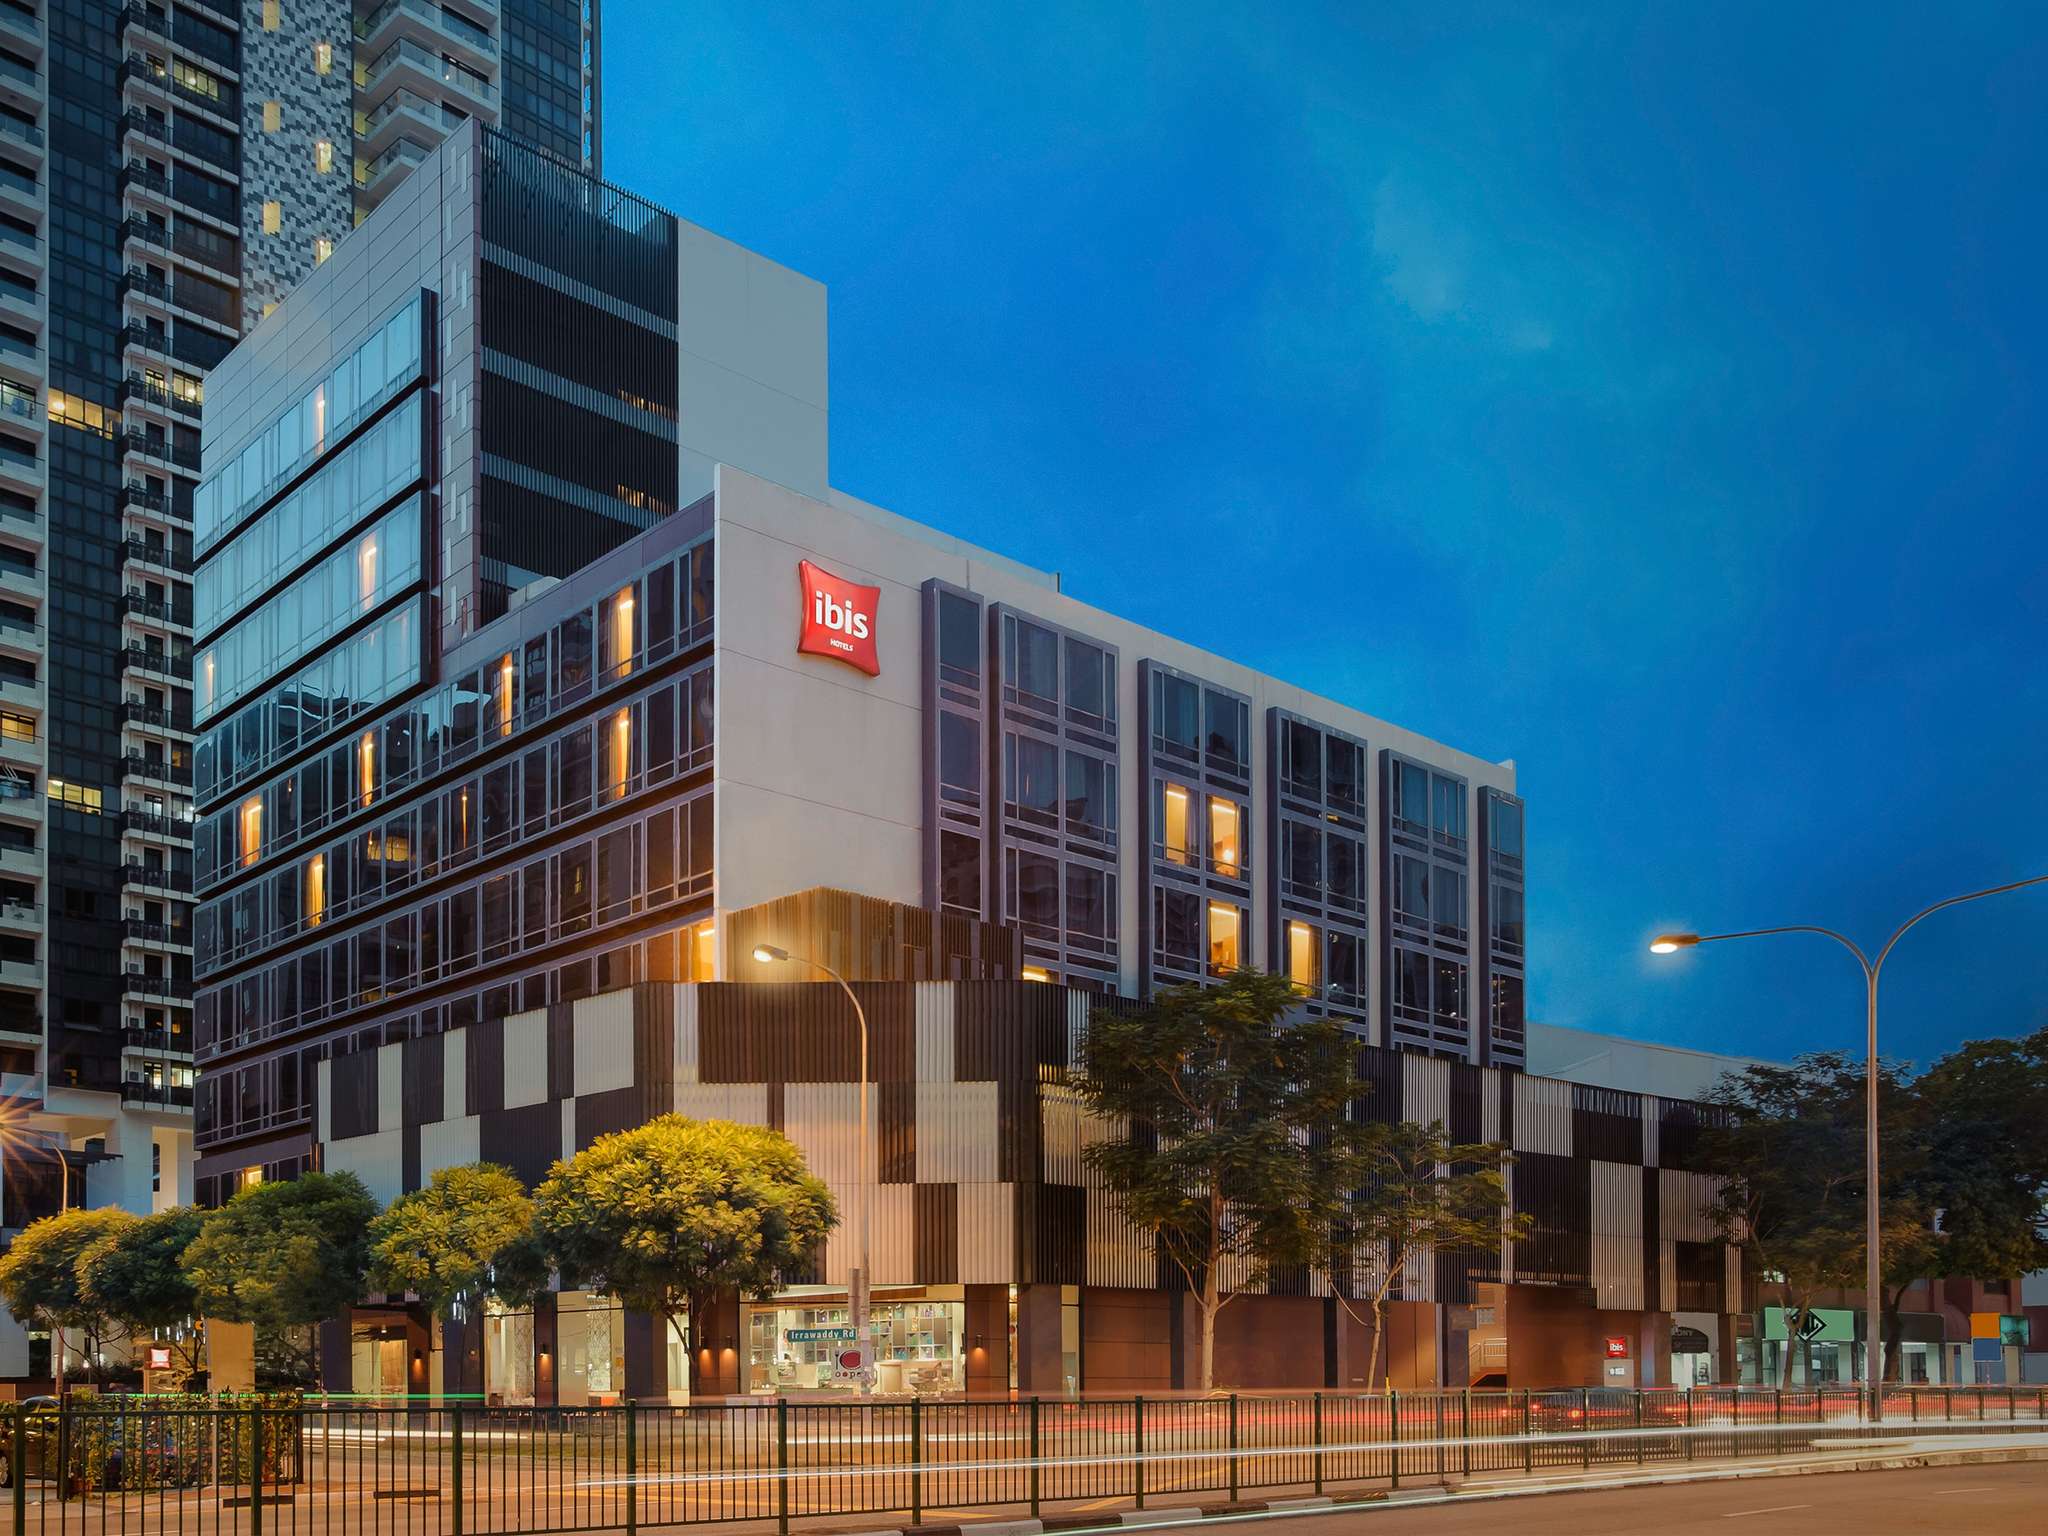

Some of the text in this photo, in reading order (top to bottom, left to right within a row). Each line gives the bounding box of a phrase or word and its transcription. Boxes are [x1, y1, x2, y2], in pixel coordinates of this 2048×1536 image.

[815, 590, 869, 639] ibis
[830, 638, 854, 652] HOTELS
[791, 1329, 854, 1340] Irrawaddy Rd
